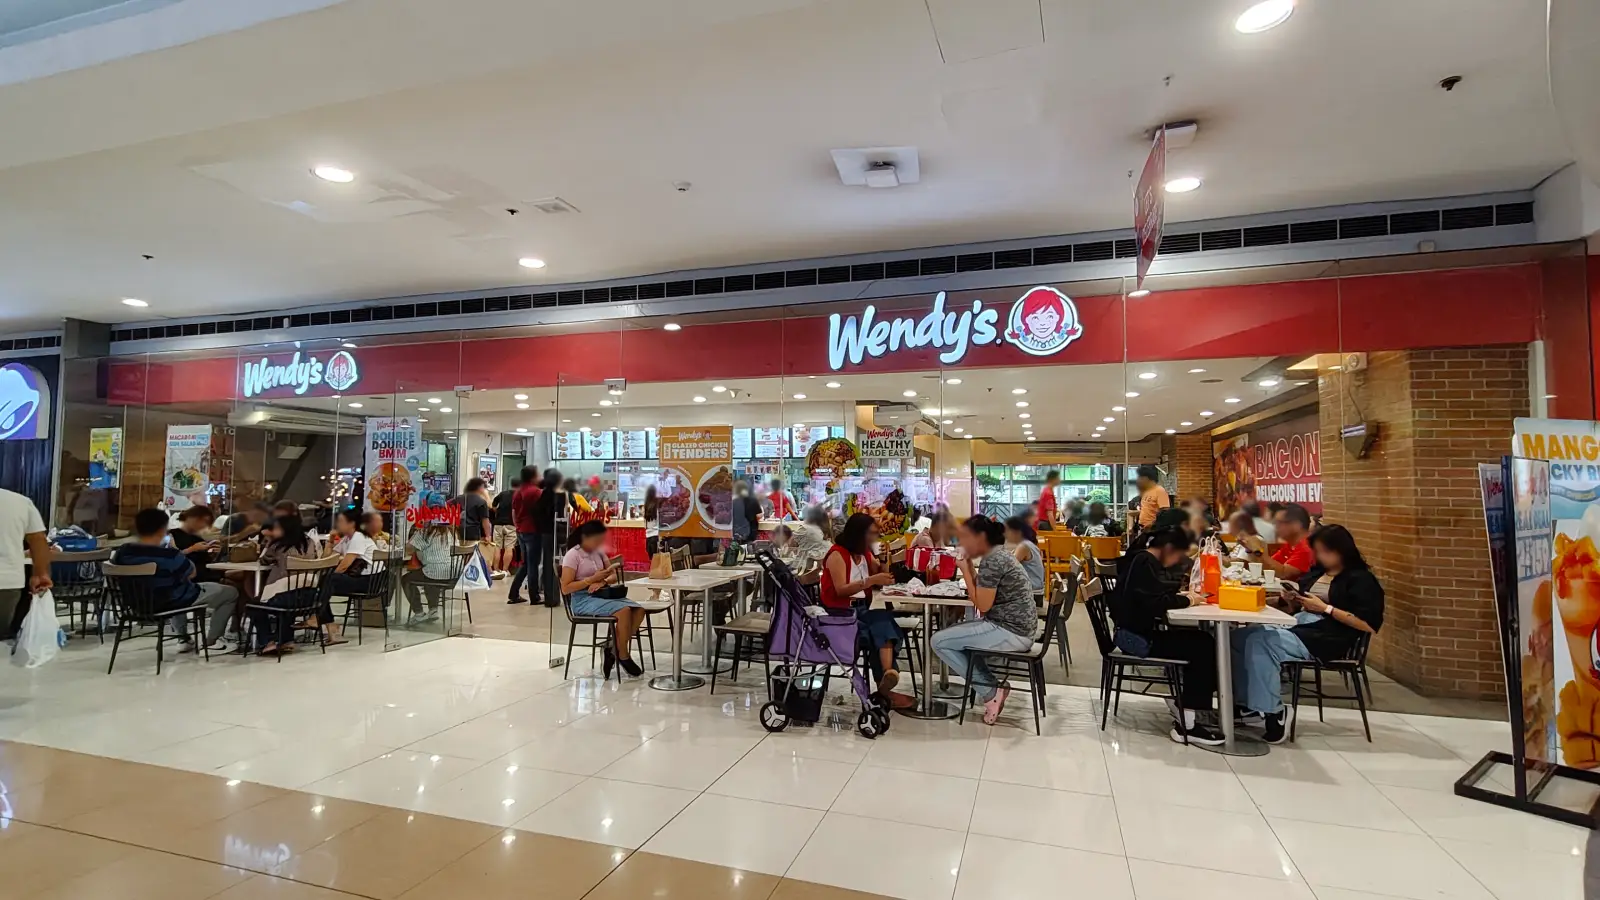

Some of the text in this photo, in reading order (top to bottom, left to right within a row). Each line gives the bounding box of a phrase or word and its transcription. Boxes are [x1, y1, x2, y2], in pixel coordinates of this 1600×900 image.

[829, 291, 999, 370] Wendy's
[244, 352, 323, 397] Wendy's
[372, 431, 415, 441] DOUBLE
[678, 430, 702, 441] Wendy's
[866, 427, 894, 440] Wendy's
[371, 440, 415, 450] DOUBLE
[861, 440, 911, 449] HEALTHY
[1521, 433, 1600, 461] MANG
[672, 448, 728, 459] TENDERS
[861, 449, 911, 457] MADE EASY
[1255, 430, 1321, 480] BACON
[1550, 463, 1583, 481] CKY
[1256, 482, 1323, 502] DELICIOUS IN EV
